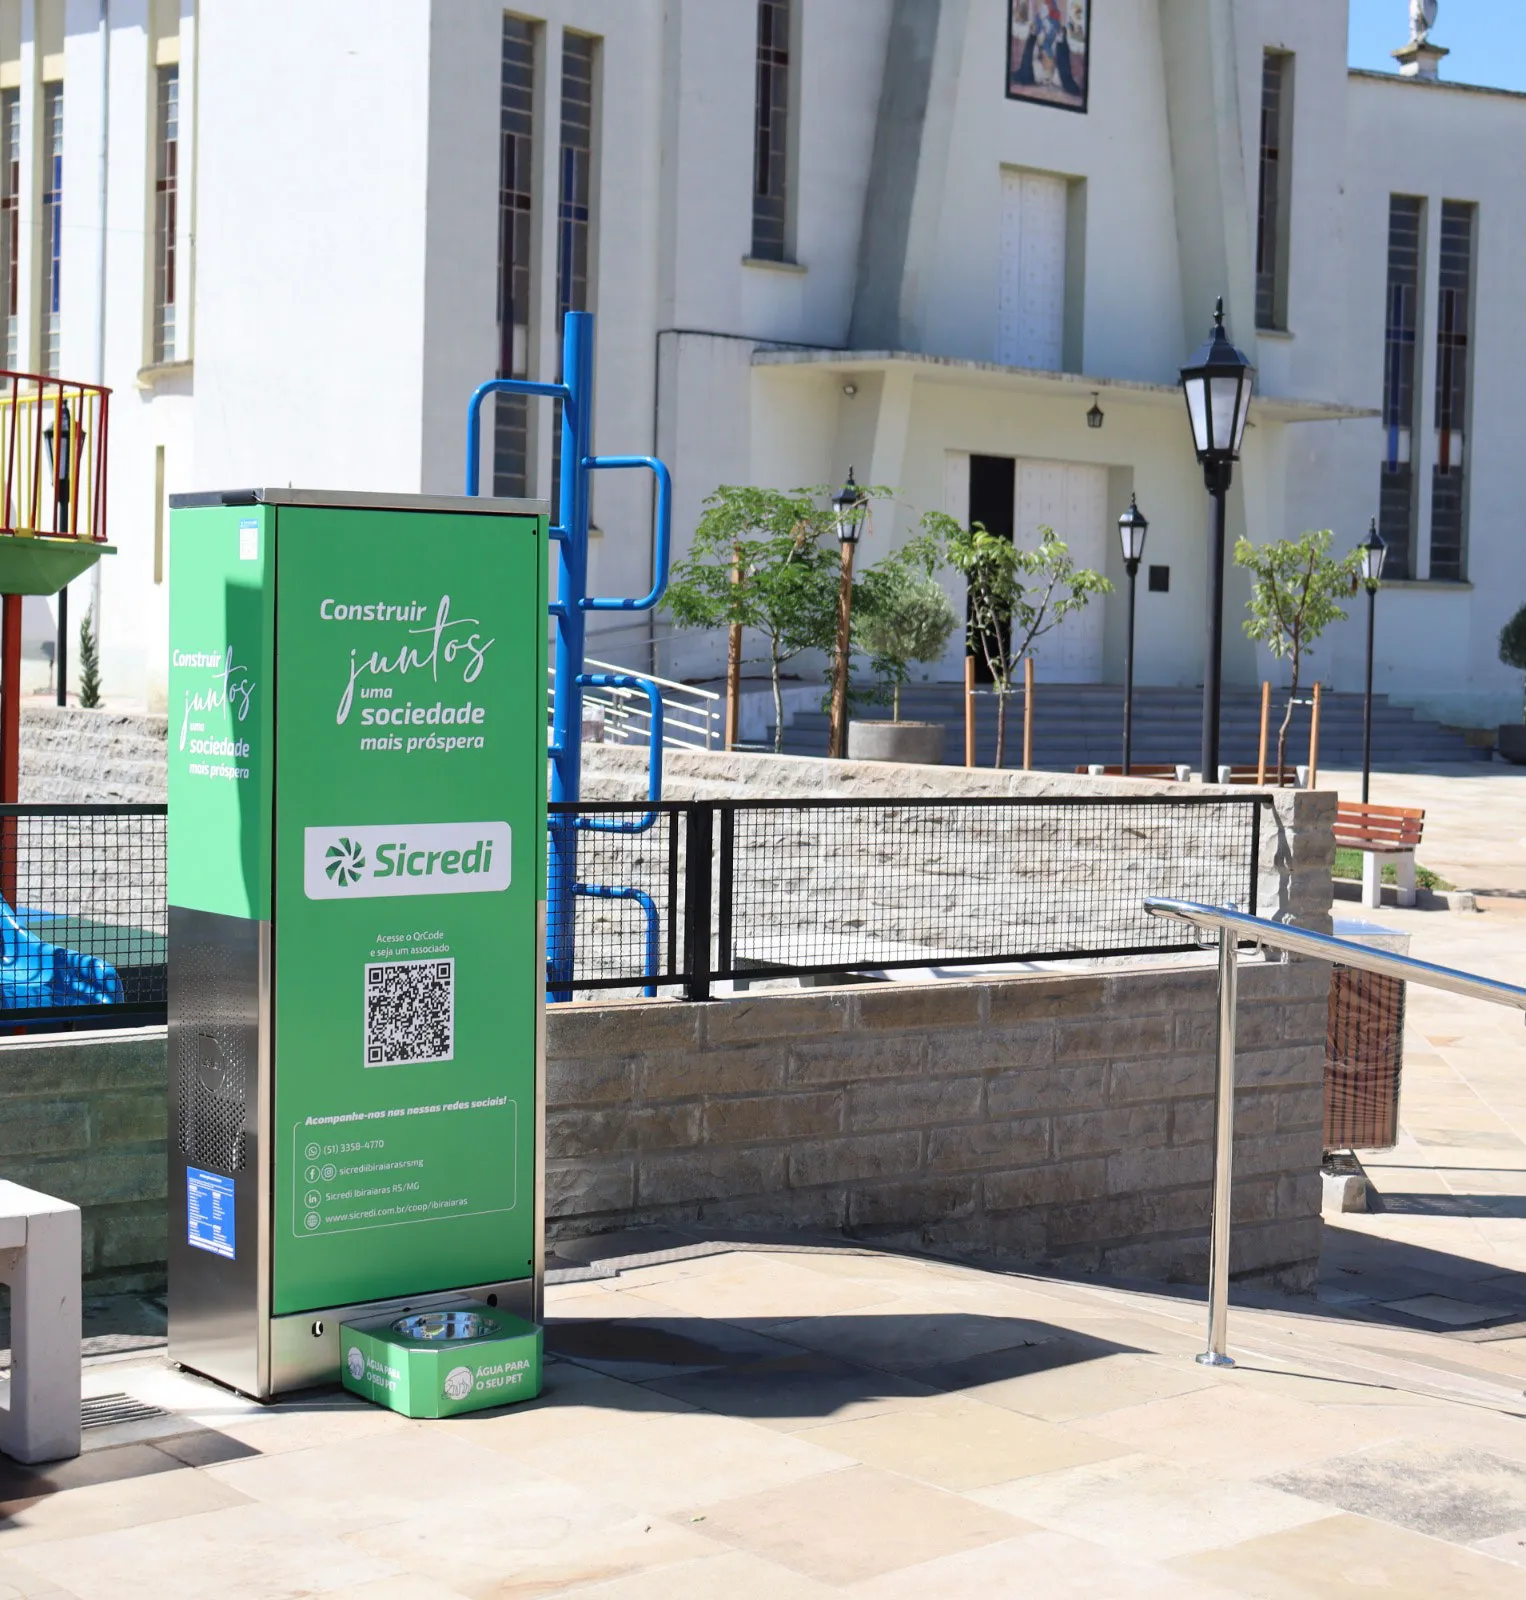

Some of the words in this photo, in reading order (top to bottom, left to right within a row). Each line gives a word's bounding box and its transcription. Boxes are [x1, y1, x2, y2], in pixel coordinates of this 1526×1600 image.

[320, 599, 427, 621] Construir
[172, 649, 221, 668] Construir
[336, 594, 495, 725] juntos
[179, 645, 255, 752] juntos
[360, 687, 393, 698] uma
[361, 702, 485, 725] sociedade
[189, 736, 250, 758] sociedade
[360, 733, 403, 750] mais
[406, 732, 485, 753] próspera
[189, 760, 210, 775] mais
[209, 762, 250, 781] próspera
[373, 840, 493, 878] Sicredi
[376, 934, 404, 943] Acesse
[413, 930, 444, 941] QrCode
[370, 949, 376, 957] e
[377, 947, 393, 959] seja
[395, 947, 409, 955] um
[410, 943, 450, 954] associado
[305, 1109, 386, 1126] Acompanhe-nos
[387, 1107, 405, 1116] nas
[406, 1104, 441, 1115] nossas
[442, 1100, 470, 1112] redes
[471, 1096, 507, 1109] sociais!
[323, 1143, 339, 1156] (51)
[340, 1139, 385, 1152] 3358-4770
[325, 1190, 353, 1202] Sicredi
[354, 1186, 391, 1198] Ibiraiaras
[392, 1181, 420, 1193] RS/MG
[325, 1198, 468, 1223] www.sicredi.com.br/coop/ibiraiaras
[366, 1356, 384, 1373] ÁGUA
[475, 1364, 504, 1378] ÁGUA
[504, 1359, 531, 1372] PARA
[366, 1371, 372, 1382] O
[372, 1374, 385, 1386] SEU
[476, 1380, 484, 1391] O
[486, 1377, 504, 1389] SEU
[505, 1372, 523, 1385] PET
